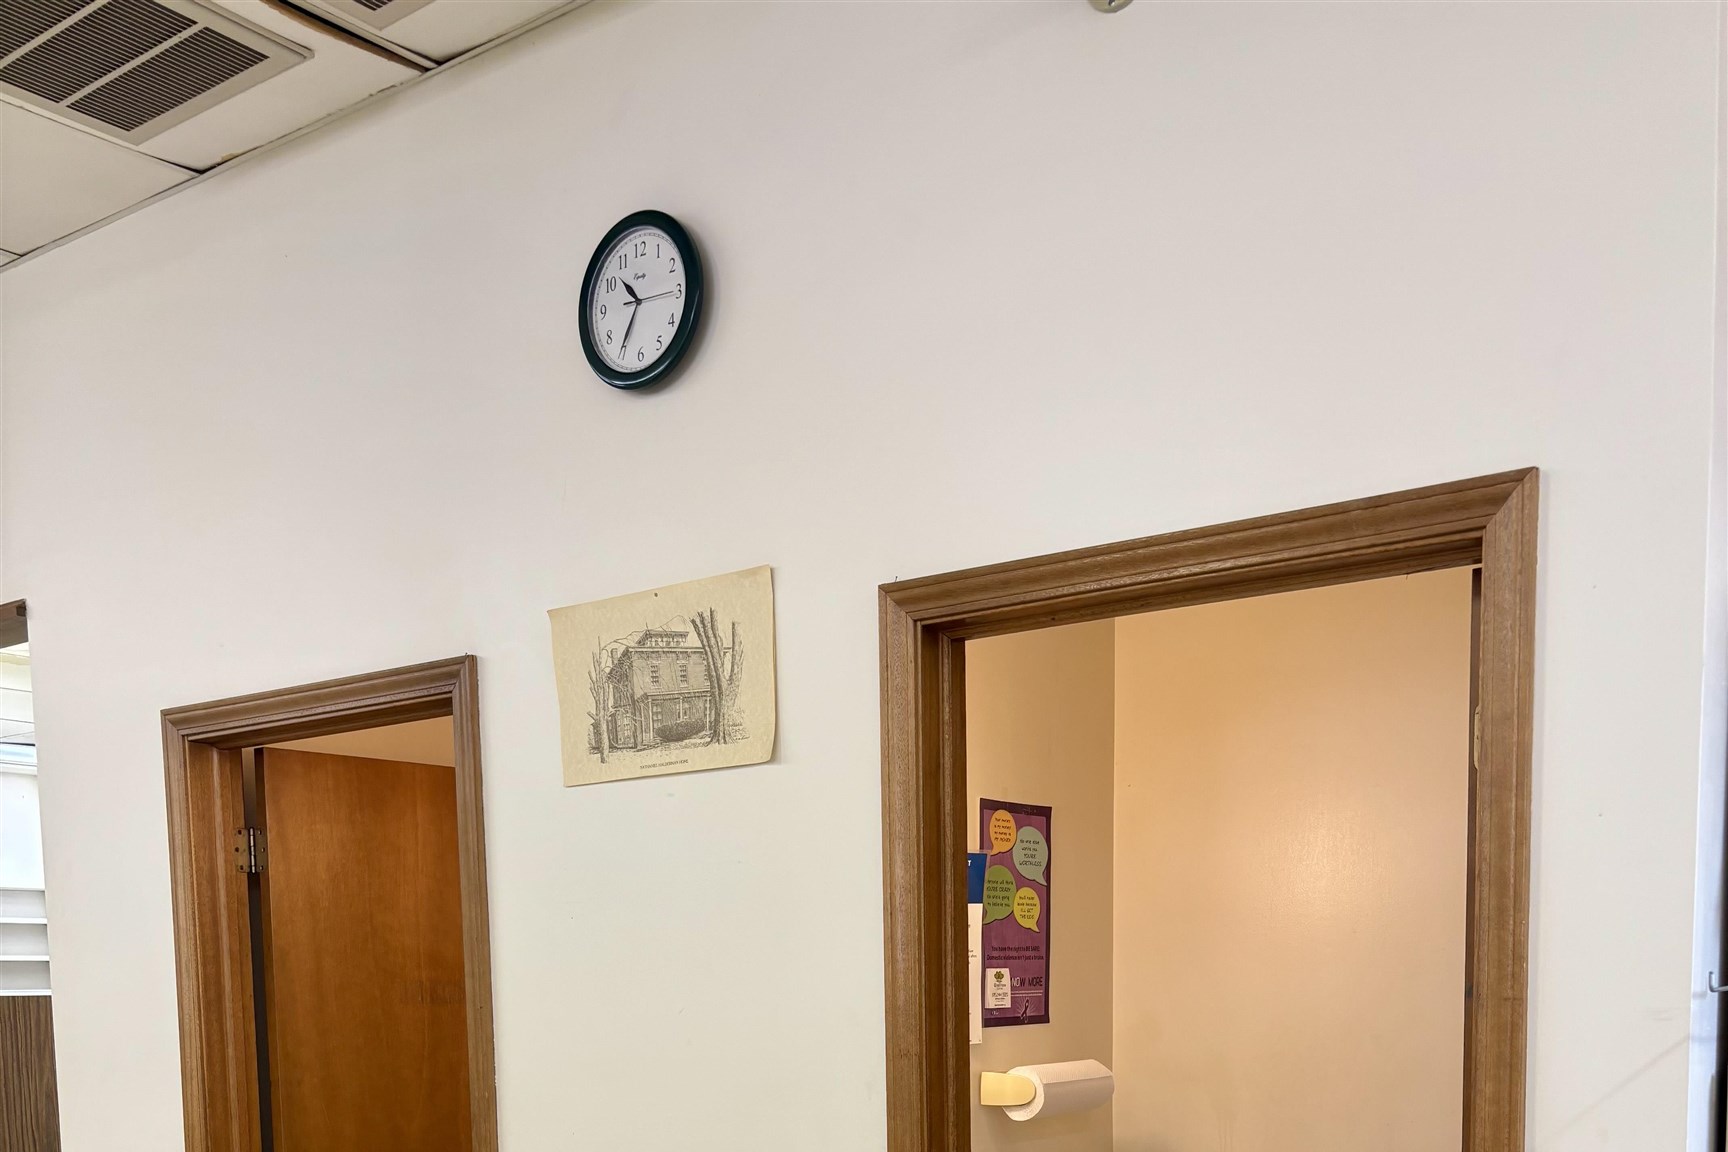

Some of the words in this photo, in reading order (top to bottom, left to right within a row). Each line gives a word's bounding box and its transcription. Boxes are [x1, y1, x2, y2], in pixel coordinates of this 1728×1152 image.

[634, 241, 647, 259] 12
[656, 243, 661, 259] 1
[619, 253, 628, 270] 11
[669, 257, 676, 274] 2
[605, 275, 617, 294] 10
[675, 283, 682, 299] 3
[600, 304, 607, 320] 9
[668, 312, 675, 328] 4
[606, 329, 613, 345] 8
[656, 335, 663, 351] 5
[637, 346, 645, 362] 6
[1028, 976, 1043, 987] MORE
